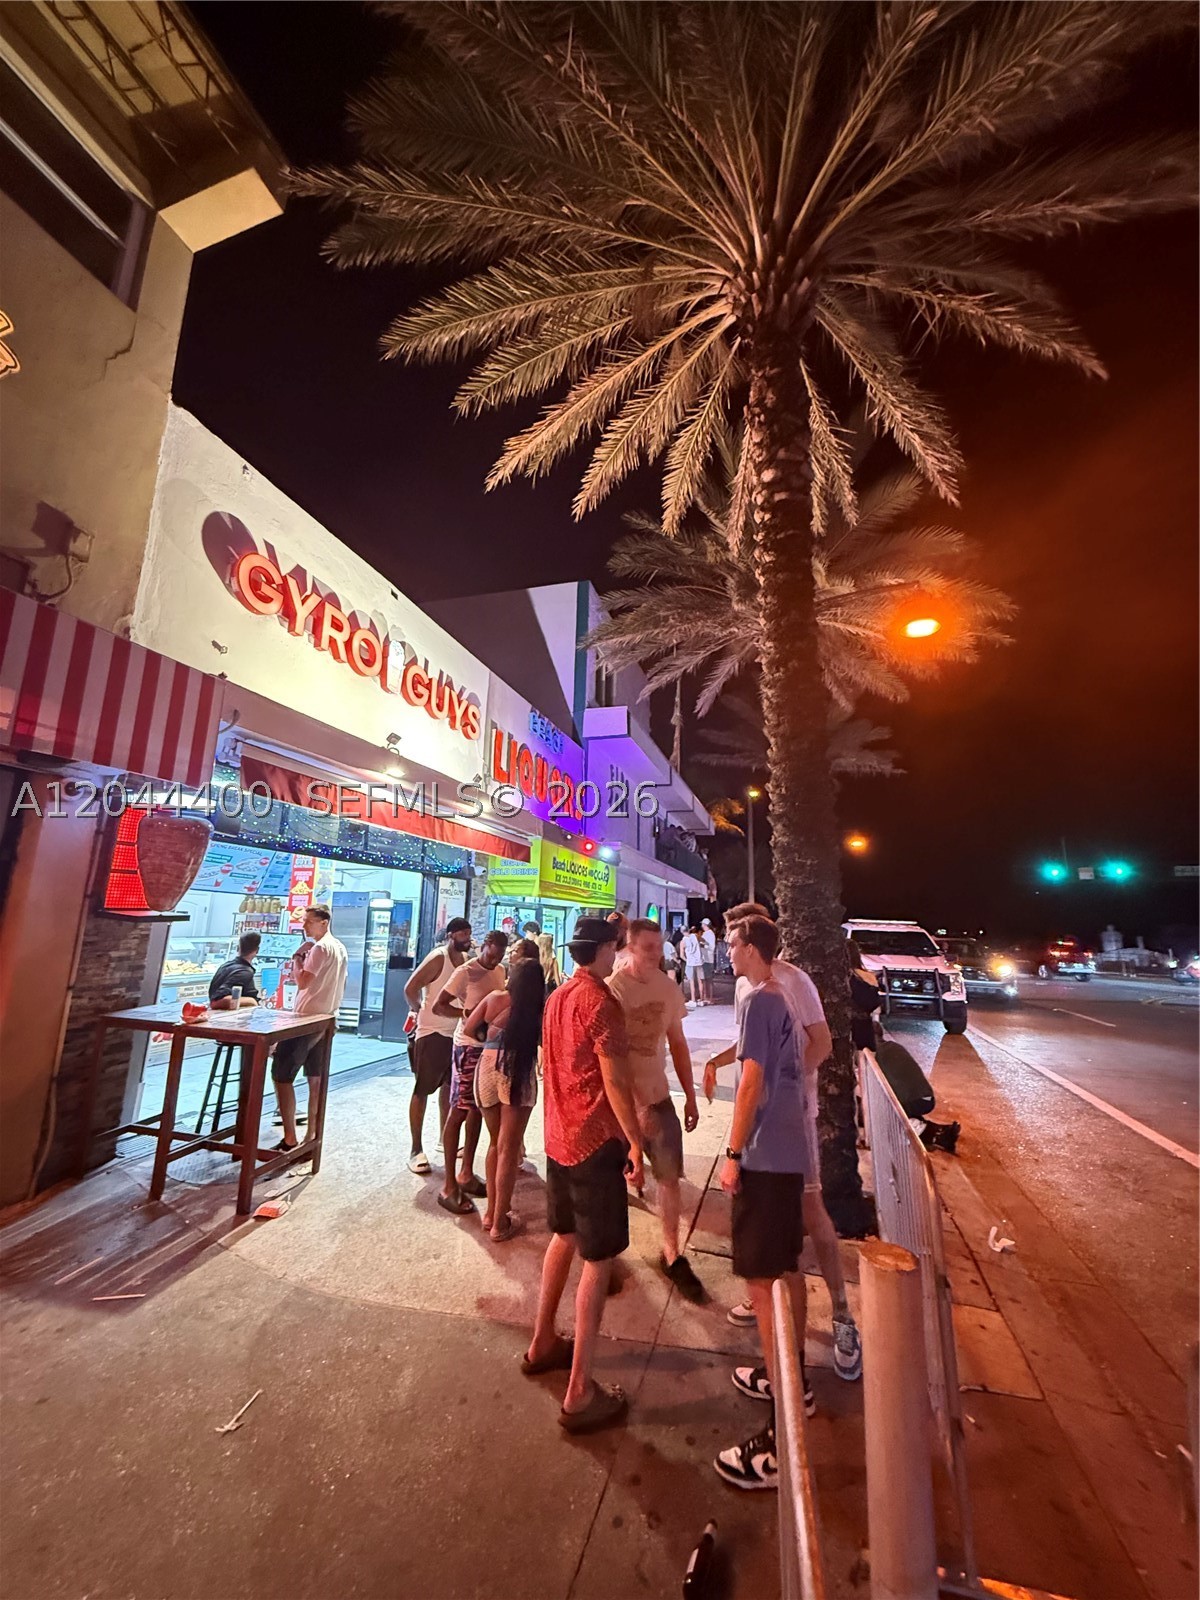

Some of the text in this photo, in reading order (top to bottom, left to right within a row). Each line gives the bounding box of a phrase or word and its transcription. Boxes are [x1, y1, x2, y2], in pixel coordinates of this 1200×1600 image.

[233, 552, 481, 740] GYRO GUYS
[490, 868, 539, 876] COLD DRINKS
